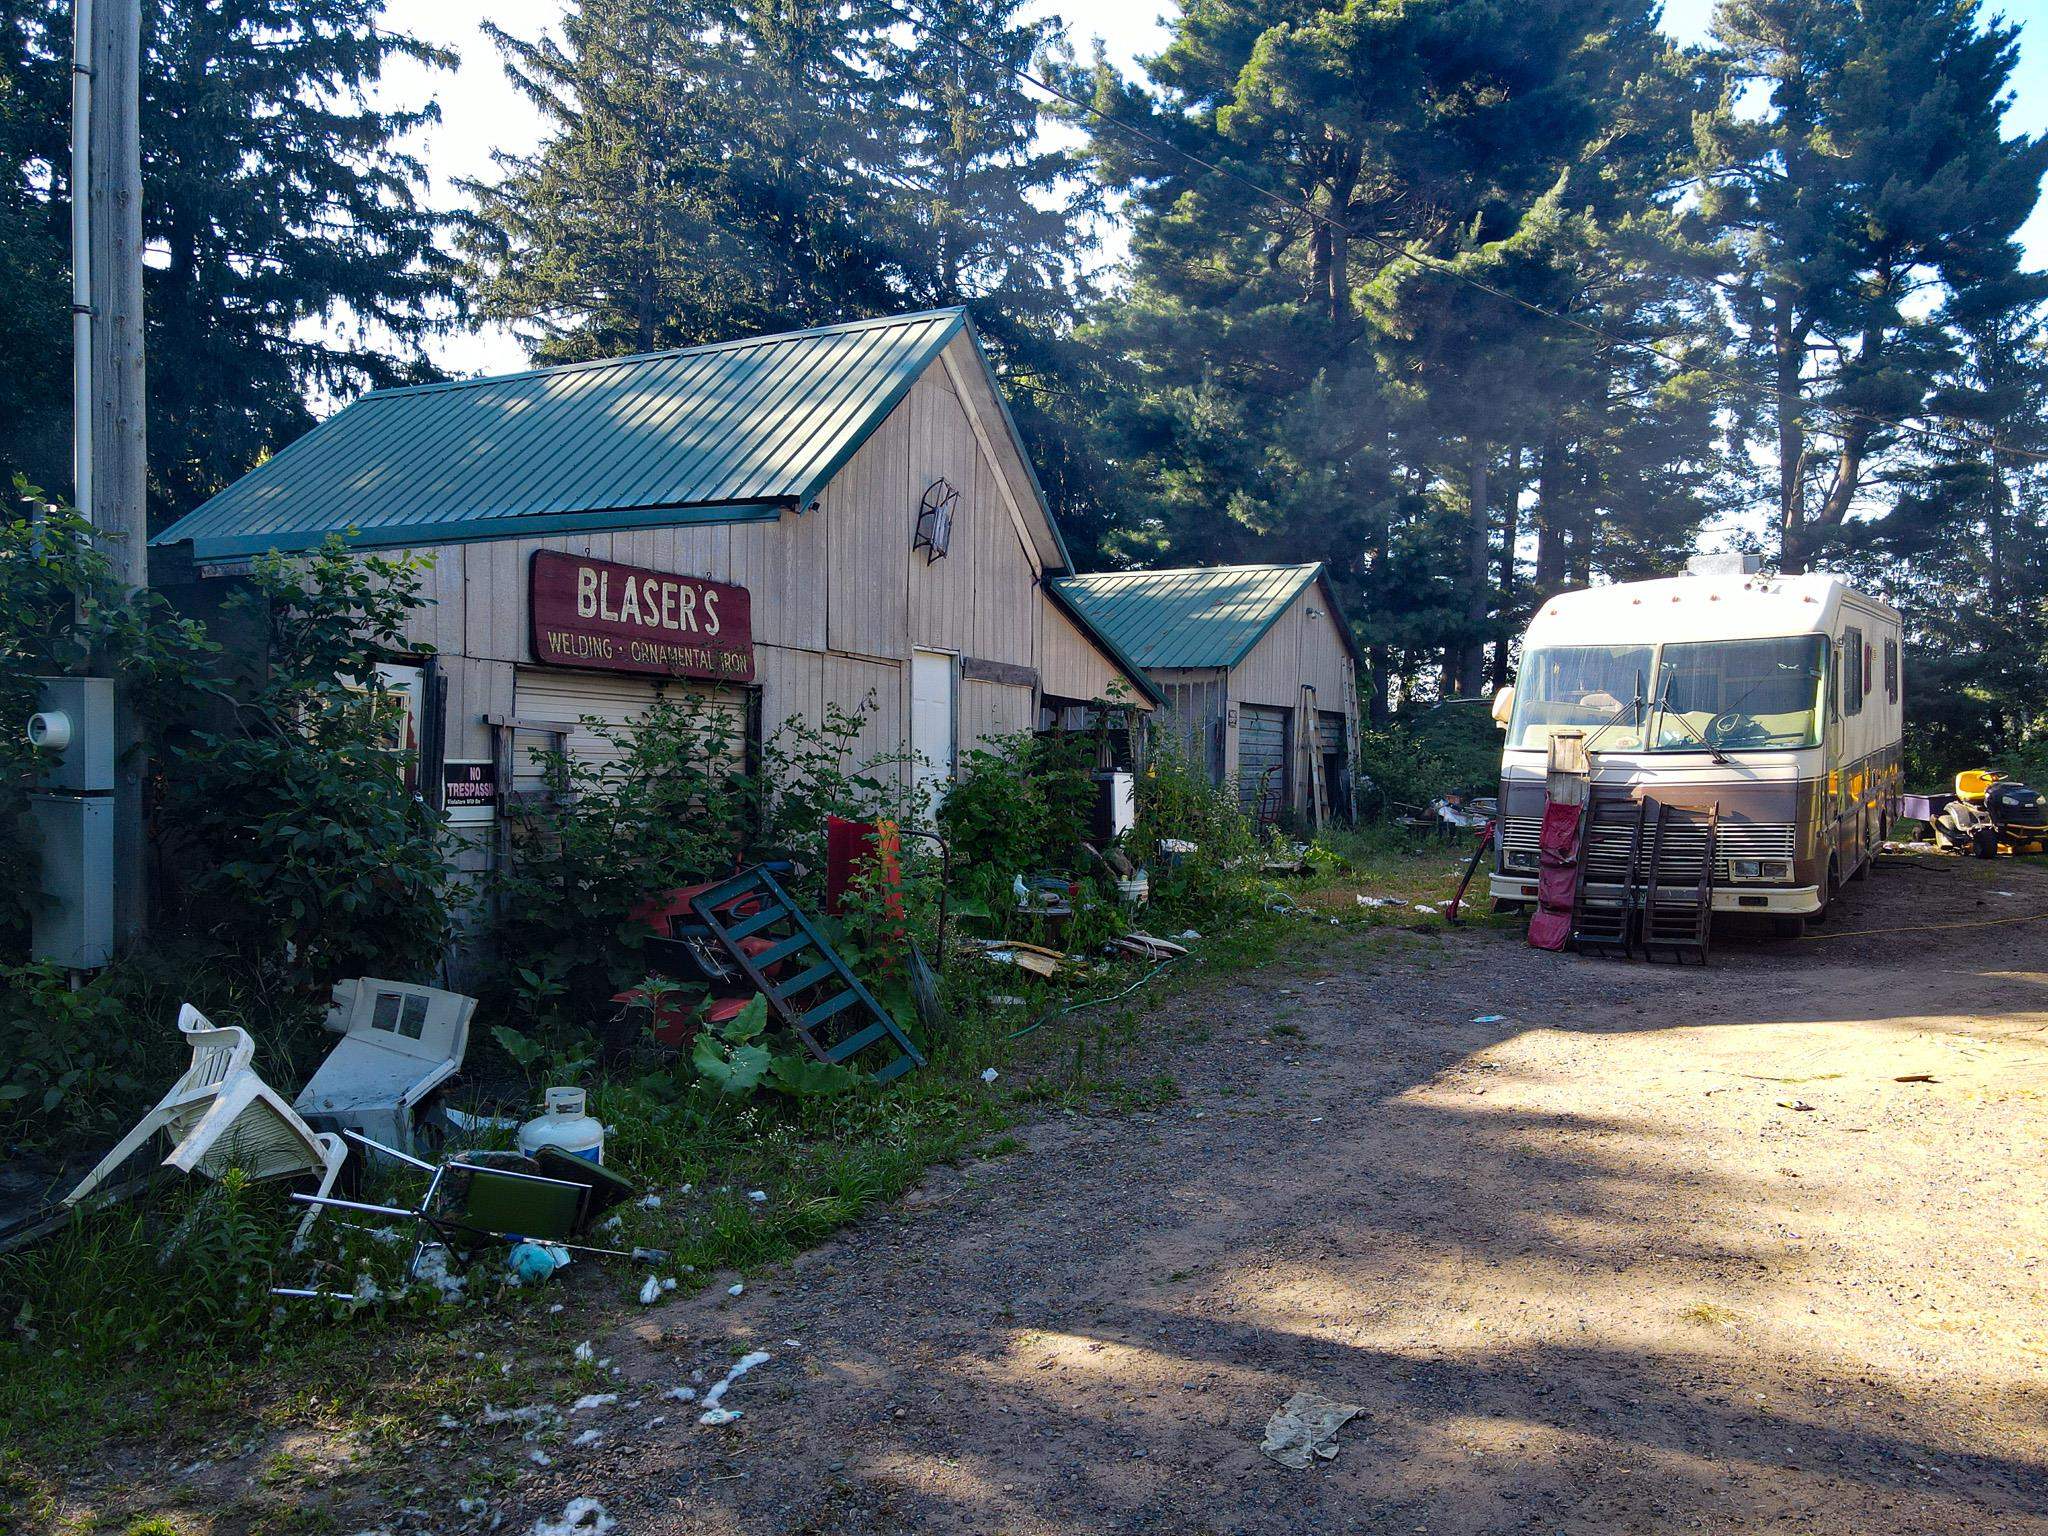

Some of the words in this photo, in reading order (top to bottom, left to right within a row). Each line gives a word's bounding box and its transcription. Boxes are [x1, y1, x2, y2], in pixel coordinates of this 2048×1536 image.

[577, 567, 720, 636] BLASER'S
[547, 631, 613, 659] WELDING
[630, 641, 715, 670] ORNAMENTAL
[720, 650, 748, 673] IRON
[469, 766, 481, 781] NO
